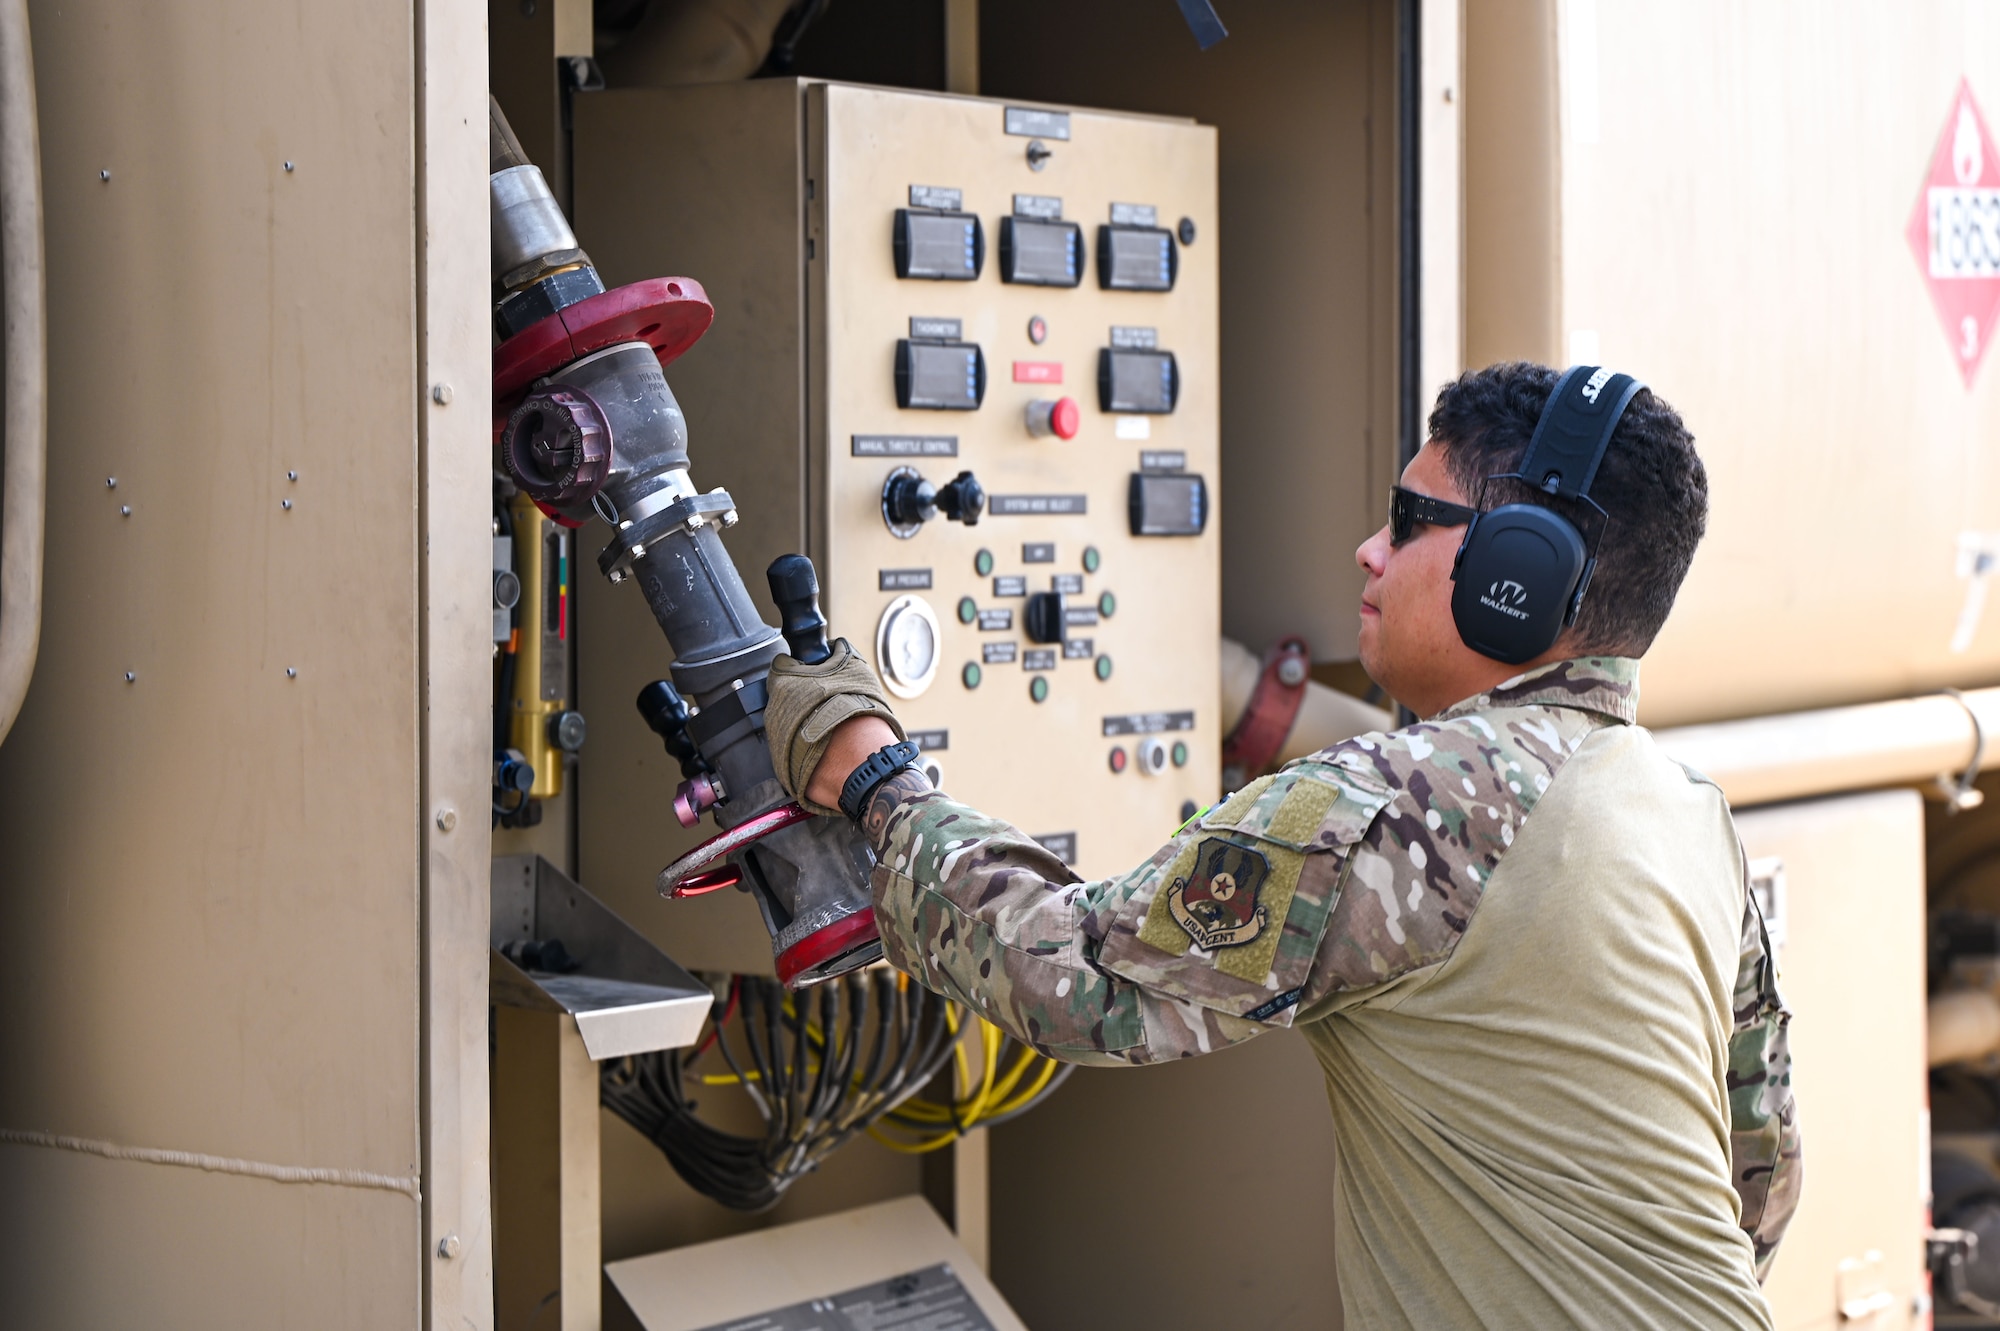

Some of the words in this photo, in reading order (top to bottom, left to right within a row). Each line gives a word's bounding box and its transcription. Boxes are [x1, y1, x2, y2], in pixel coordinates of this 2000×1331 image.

[1960, 315, 1979, 360] 3
[509, 401, 539, 426] CHANGE
[543, 401, 554, 411] TO
[556, 407, 571, 422] PIN
[503, 430, 517, 474] POSITION
[569, 424, 581, 469] LOCKING
[558, 472, 575, 489] PULL
